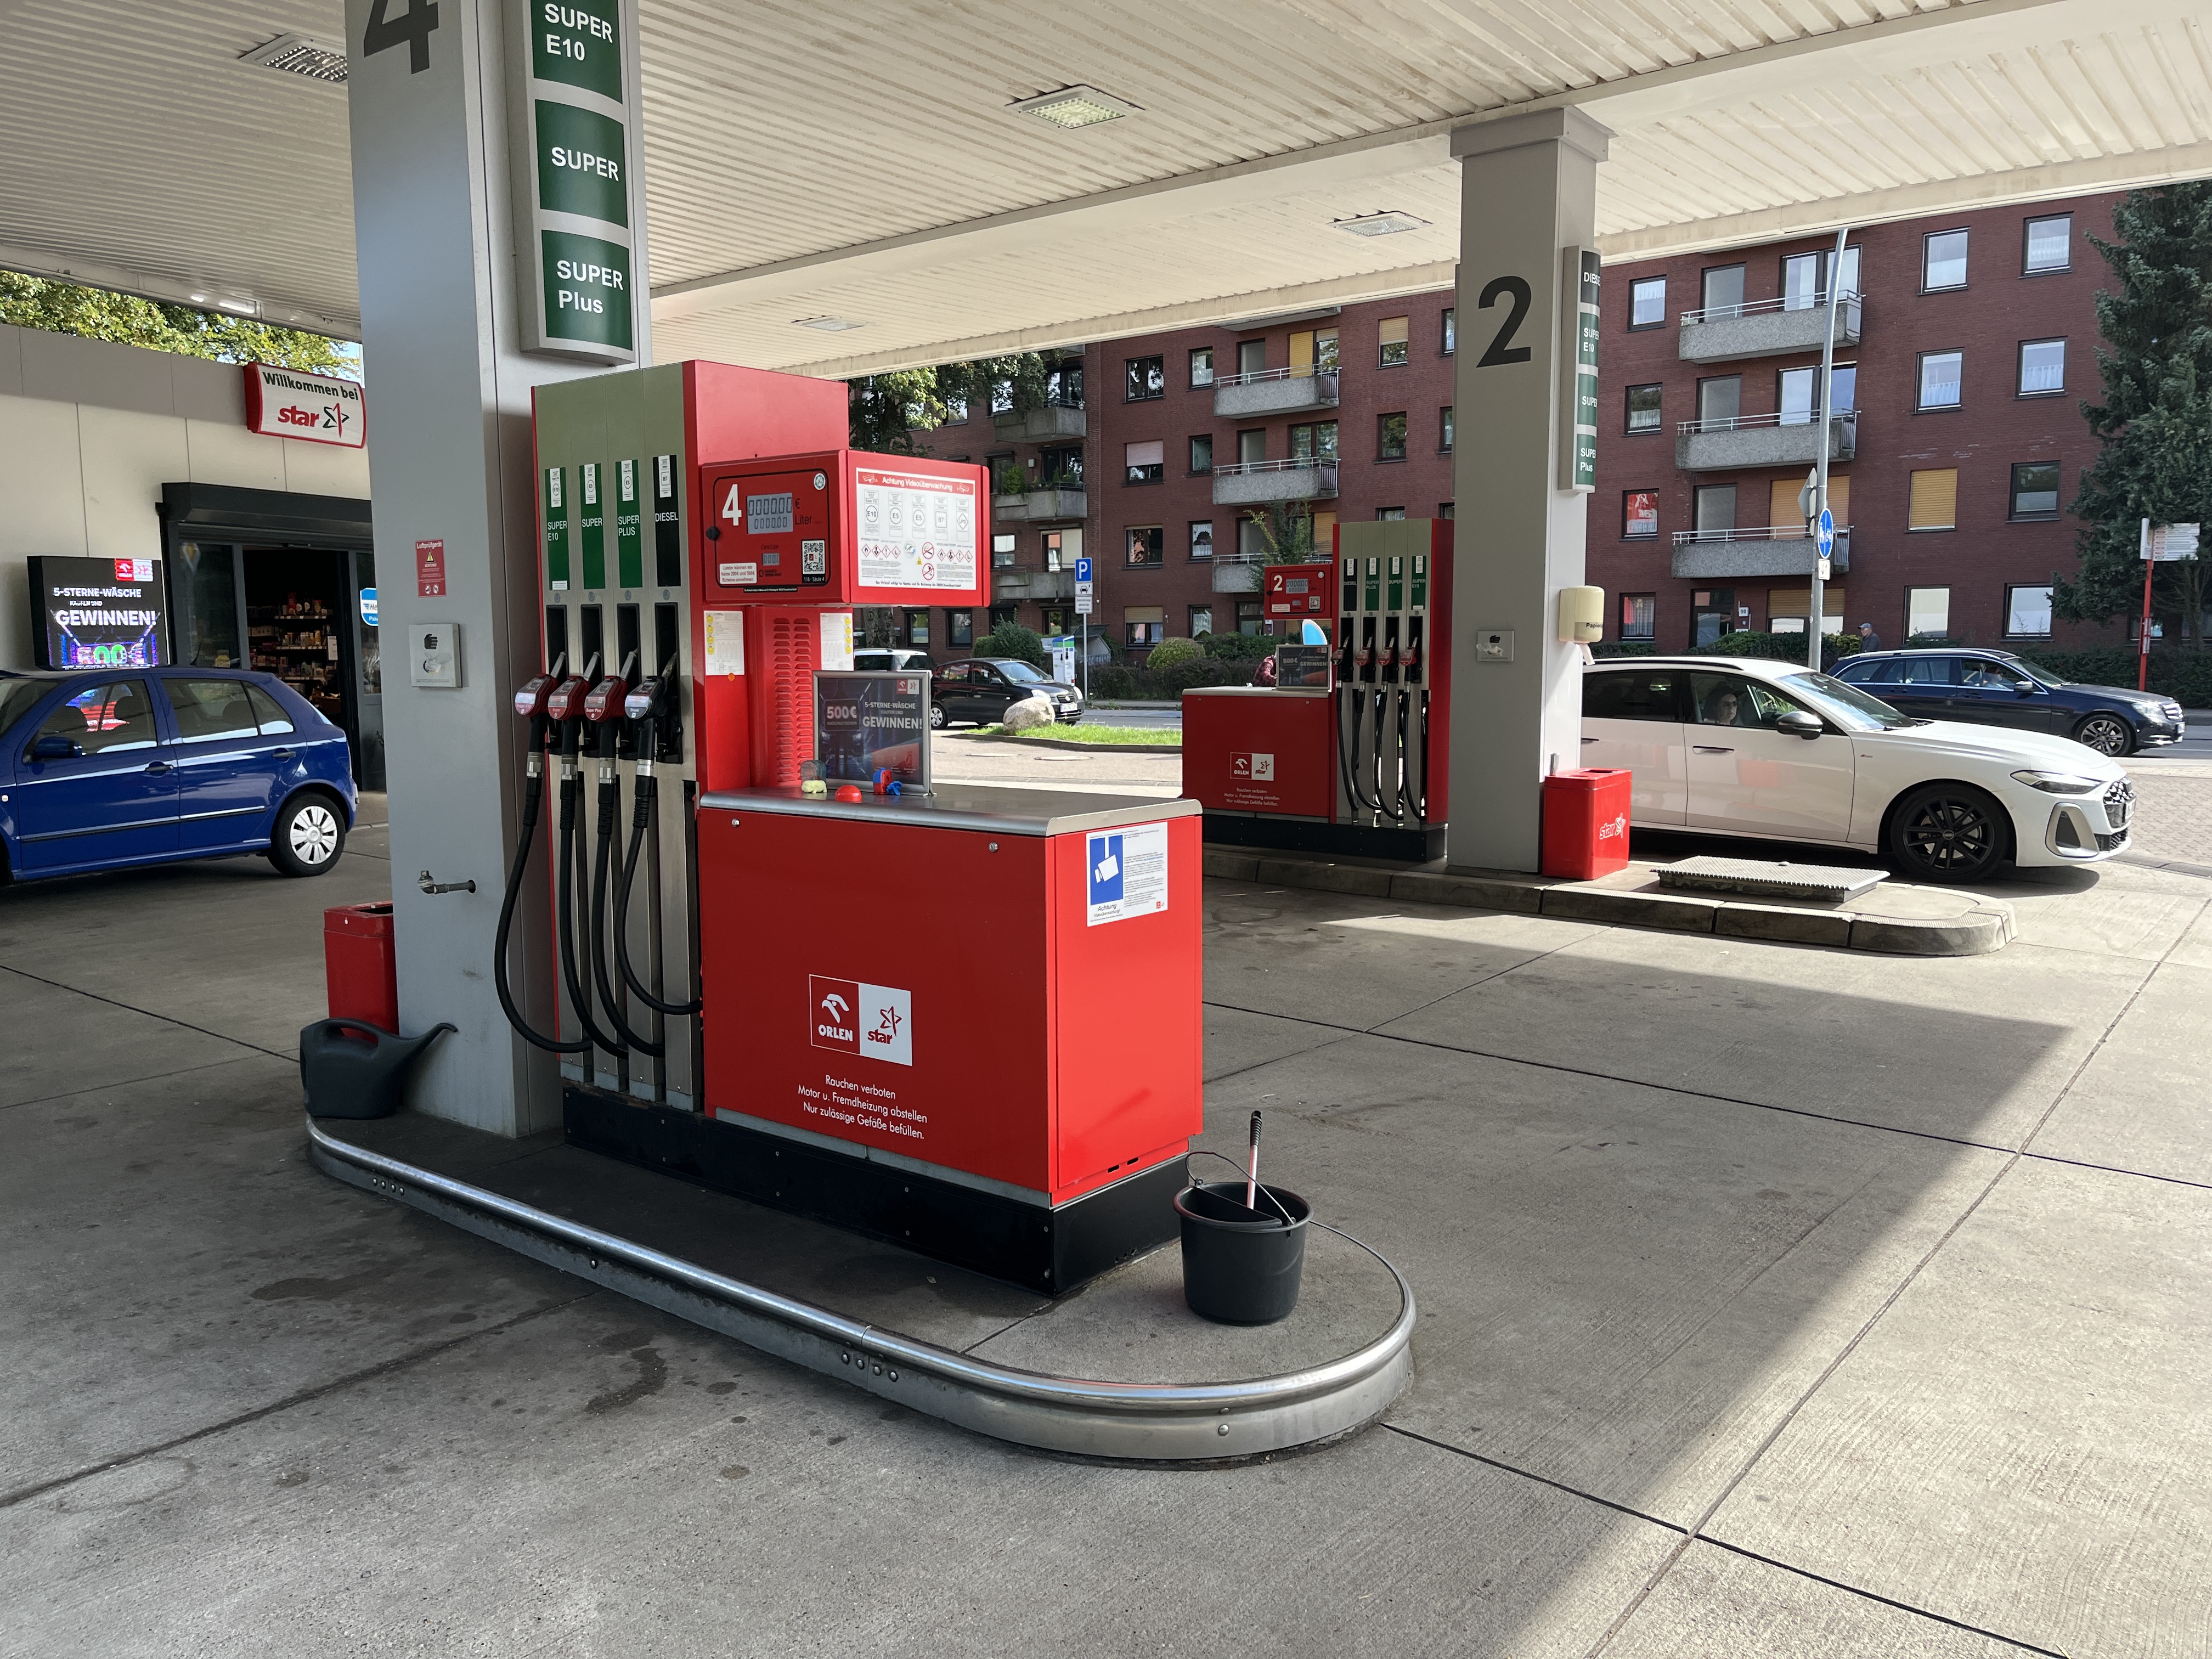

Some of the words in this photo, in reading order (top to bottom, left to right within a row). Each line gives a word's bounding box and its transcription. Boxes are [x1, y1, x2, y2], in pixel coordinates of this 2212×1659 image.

[545, 3, 613, 43] SUPER
[364, 0, 439, 75] 4
[546, 34, 585, 61] E10
[551, 146, 619, 182] SUPER
[557, 260, 623, 291] SUPER
[558, 290, 603, 314] Plus
[1476, 275, 1532, 368] 2
[1583, 327, 1599, 341] SUPE
[1583, 342, 1595, 353] E10
[262, 371, 339, 397] Willkommen
[340, 386, 359, 400] bei
[1582, 396, 1598, 408] SUPE
[278, 405, 319, 427] star
[1580, 447, 1596, 459] SUPE
[1580, 461, 1593, 472] Plus
[882, 476, 905, 487] Achtung
[905, 479, 953, 492] Videoüberwachung
[722, 484, 742, 526] 4
[582, 517, 602, 527] SUPER
[618, 515, 640, 525] SUPER
[655, 511, 678, 522] DIESEL
[795, 515, 812, 525] Liter
[548, 521, 567, 531] SUPER
[618, 527, 635, 537] PLUS
[548, 532, 558, 541] E10
[1079, 561, 1088, 579] P
[1273, 575, 1283, 591] 2
[53, 586, 142, 598] 5-STERNE-WÄSCHE
[55, 610, 156, 626] GEWINNEN!
[827, 706, 857, 719] 500€
[865, 701, 916, 709] 5-STERNE-WÄSCHE
[862, 716, 922, 730] GEWINNEN!
[1599, 822, 1615, 840] star
[818, 1024, 854, 1042] ORLEN
[867, 1029, 893, 1045] star
[825, 1074, 859, 1092] Rauchen
[861, 1084, 896, 1100] verboten
[798, 1084, 821, 1099] Motor
[822, 1093, 830, 1102] u.
[832, 1092, 889, 1117] Fremdheizung
[890, 1105, 928, 1124] abstellen
[803, 1101, 818, 1114] Nur
[820, 1107, 855, 1124] zulässige
[857, 1114, 887, 1131] Gefäße
[889, 1120, 925, 1139] befüllen.
